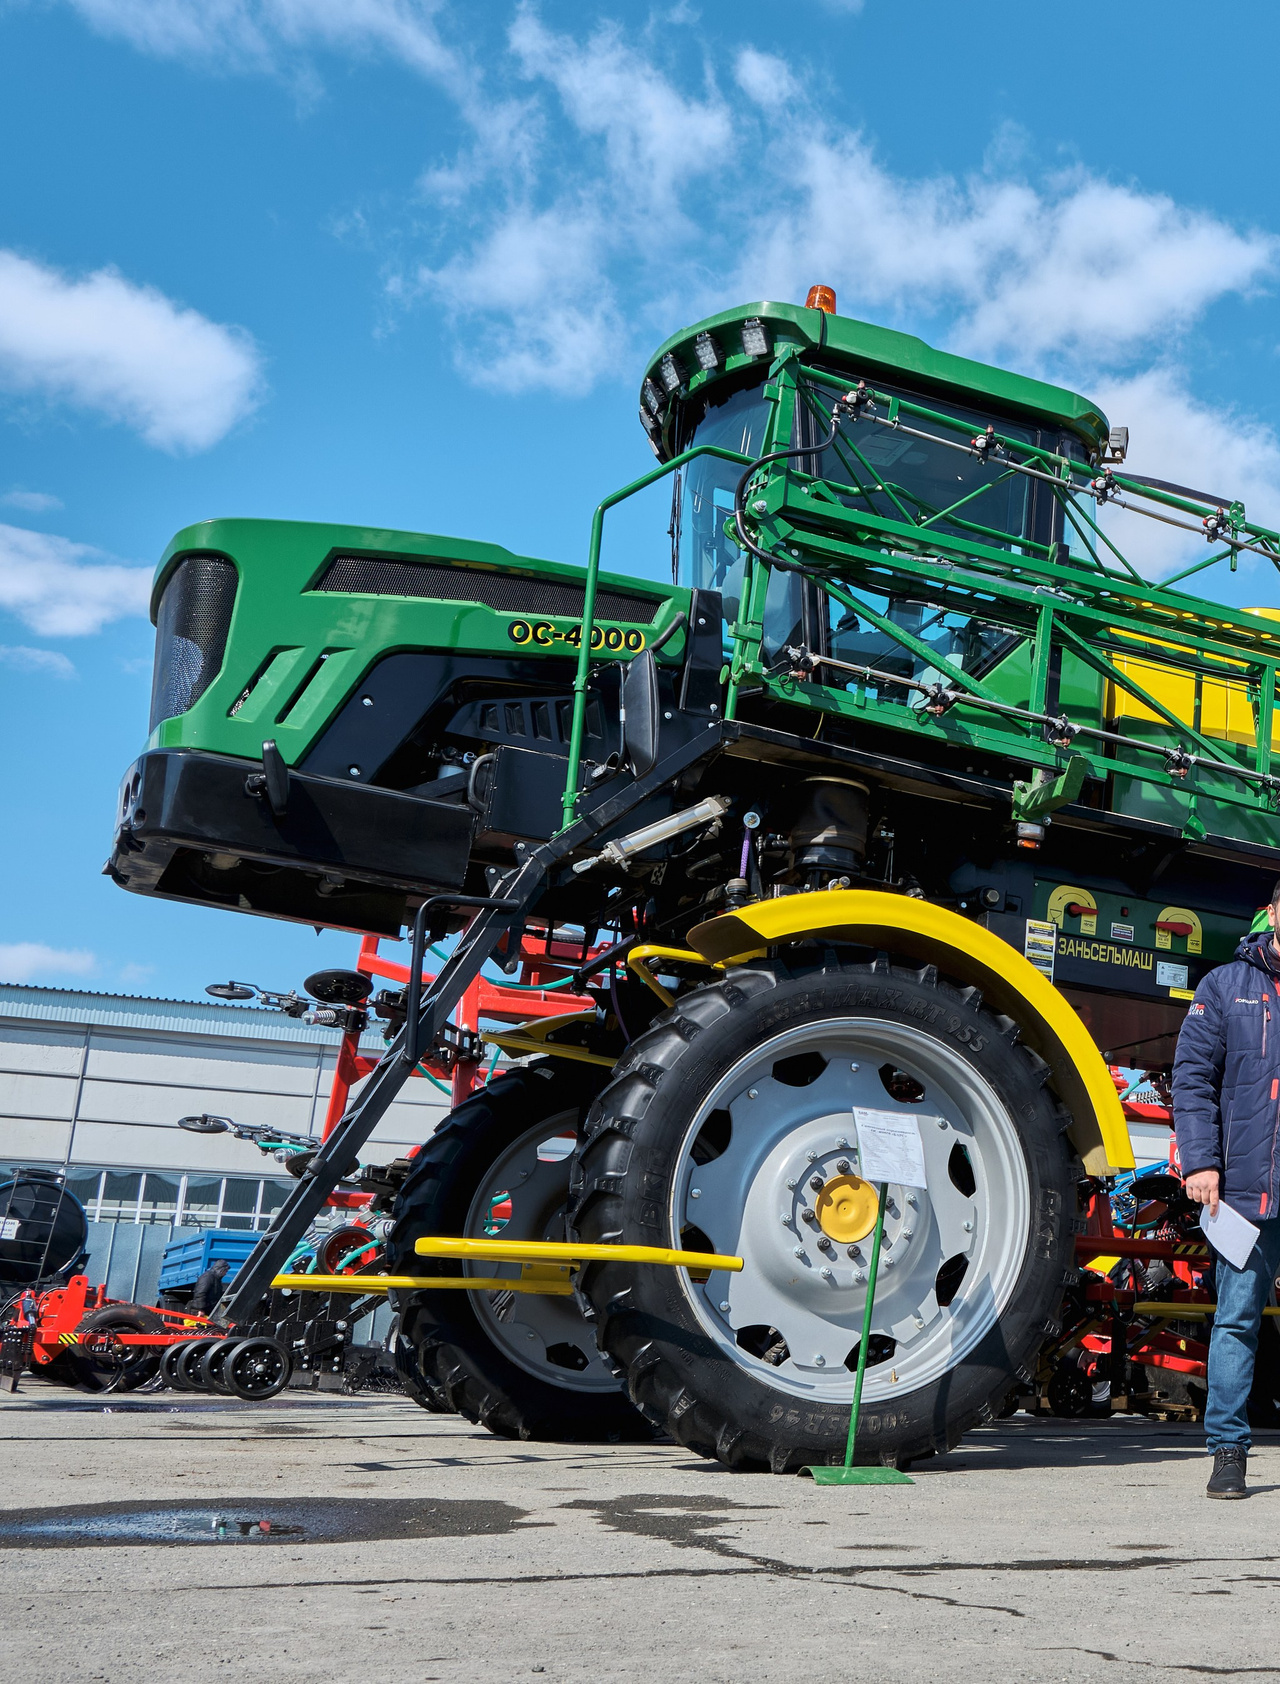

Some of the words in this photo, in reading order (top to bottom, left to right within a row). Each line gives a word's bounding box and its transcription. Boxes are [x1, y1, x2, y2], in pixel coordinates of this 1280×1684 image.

[507, 619, 646, 654] ОС-4000
[1058, 937, 1153, 970] ЗАНЬСЕЛЬМАШ
[945, 1013, 990, 1052] 955
